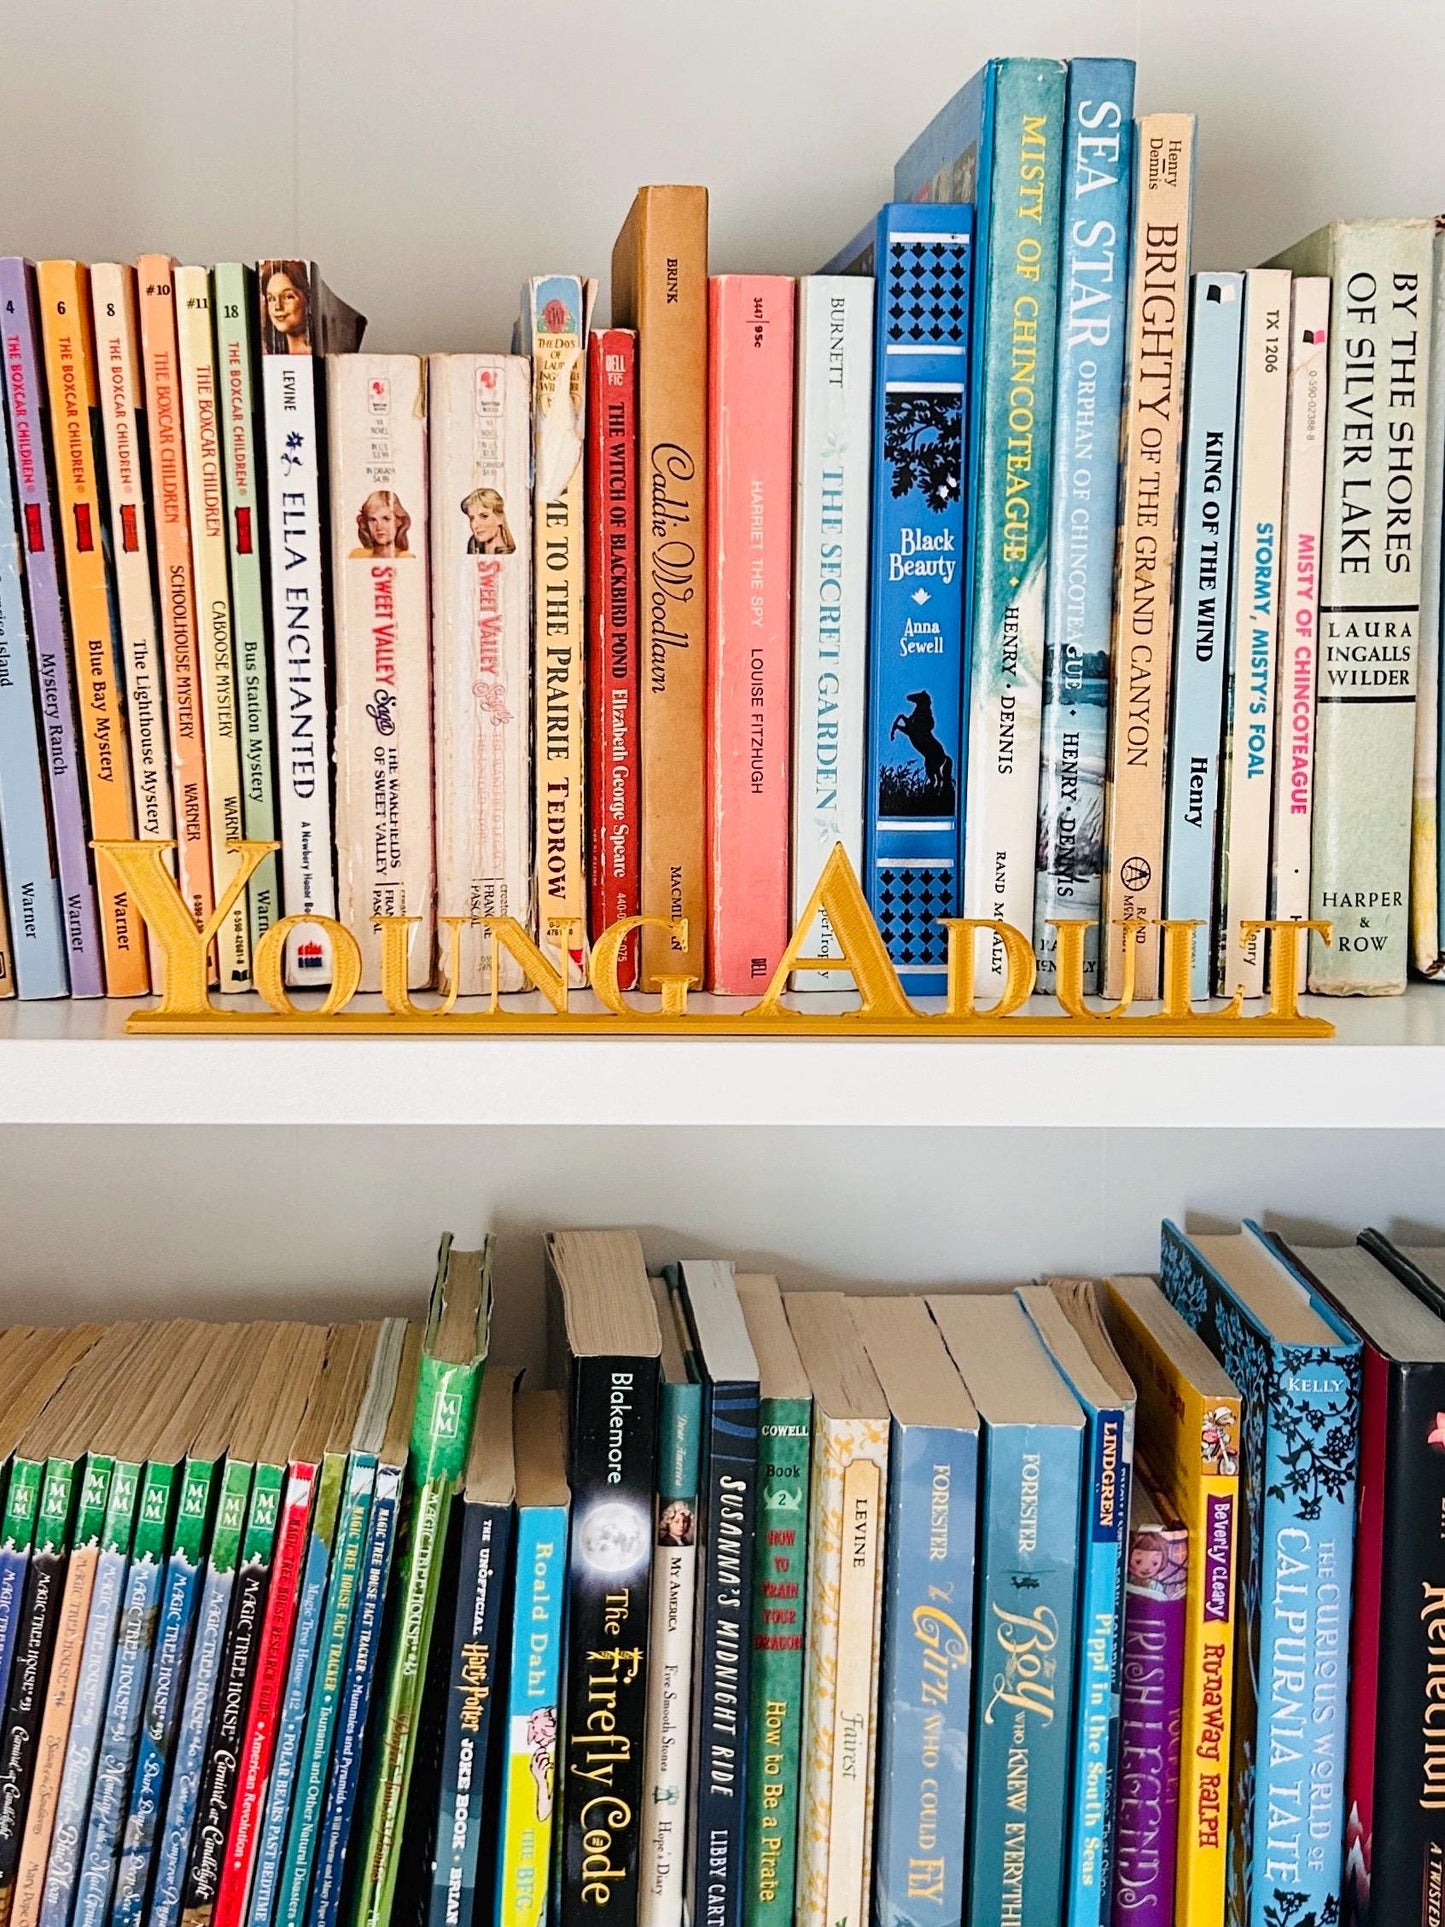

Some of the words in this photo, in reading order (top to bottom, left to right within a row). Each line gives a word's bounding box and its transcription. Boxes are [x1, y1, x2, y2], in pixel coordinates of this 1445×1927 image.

[1018, 114, 1046, 225] MISTY
[1075, 99, 1122, 199] SEA
[1148, 138, 1163, 190] Dennis
[1164, 140, 1182, 187] Henry
[666, 258, 678, 305] BRINK
[1016, 238, 1042, 282] OF
[1067, 219, 1116, 351] STAR
[6, 301, 15, 315] 4
[56, 301, 65, 315] 6
[107, 303, 116, 317] 8
[145, 285, 170, 296] #10
[187, 298, 208, 310] #11
[224, 305, 240, 319] 18
[754, 298, 764, 320] 3447
[1346, 272, 1377, 324] OF
[1392, 272, 1419, 319] BY
[829, 298, 845, 390] BURNETT
[1138, 222, 1180, 421] BRIGHTY
[1265, 310, 1279, 331] TX
[154, 351, 169, 381] THE
[1264, 338, 1279, 374] 1206
[1389, 331, 1417, 408] THE
[157, 386, 174, 444] BOXCAR
[282, 370, 297, 412] LEVINE
[1074, 361, 1097, 459] ORPHAN
[1343, 338, 1377, 469] SILVER
[608, 402, 625, 437] THE
[1002, 295, 1038, 562] CHINCOTEAGUE
[1140, 428, 1162, 464] OF
[159, 448, 180, 525] CHILDREN
[609, 443, 627, 502] WITCH
[651, 443, 695, 538] Caddie
[1072, 469, 1092, 501] OF
[1383, 422, 1414, 574] SHORES
[610, 506, 627, 530] OF
[750, 480, 764, 551] HARRIET
[1137, 472, 1160, 527] THE
[282, 493, 307, 570] ELLA
[900, 527, 955, 556] Black
[1338, 480, 1372, 574] LAKE
[546, 536, 569, 571] TO
[750, 560, 764, 589] THE
[889, 553, 956, 584] Beauty
[1249, 522, 1273, 621] STORMY,
[610, 534, 628, 628] BLACKBIRD
[1065, 508, 1089, 690] CHINCOTEAGUE
[1132, 536, 1157, 635] GRAND
[169, 565, 188, 673] SCHOOLHOUSE
[546, 580, 569, 636] THE
[651, 541, 695, 694] Woodlawn
[751, 595, 764, 627] SPY
[904, 617, 941, 637] Anna
[1328, 623, 1411, 638] LAURA
[88, 640, 104, 676] Blue
[611, 632, 628, 679] POND
[900, 636, 944, 657] Sewell
[1248, 629, 1269, 715] MISTY'S
[1326, 646, 1411, 662] INGALLS
[89, 681, 107, 712] Bay
[286, 588, 314, 800] ENCHANTED
[751, 648, 764, 707] LOUISE
[1327, 670, 1411, 686] WILDER
[175, 676, 194, 740] MYSTERY
[545, 647, 572, 761] PRAIRIE
[611, 690, 629, 762] Elizabeth
[1127, 645, 1153, 768] CANYON
[92, 717, 113, 783] Mystery
[751, 714, 764, 795] FITZHUGH
[1060, 733, 1080, 802] HENRY
[1247, 725, 1266, 780] FOAL
[184, 783, 201, 842] WARNER
[609, 766, 629, 821] George
[299, 831, 312, 870] Newbery
[547, 777, 570, 901] TEDROW
[609, 824, 629, 879] Speare
[1057, 818, 1076, 897] DENNIS
[303, 873, 313, 899] Honor
[1322, 892, 1403, 908] HARPER
[90, 840, 698, 1017] YOUNG
[757, 840, 1333, 1018] ADULT
[1338, 937, 1388, 952] ROW
[1287, 1378, 1344, 1393] KELLY
[608, 1373, 632, 1484] Blakemore
[761, 1426, 808, 1438] COWELL
[764, 1464, 801, 1480] Book
[1099, 1422, 1118, 1527] LINDGREN
[778, 1494, 786, 1507] 2
[1019, 1453, 1041, 1554] FORESTER
[716, 1475, 746, 1607] SUSANNA'S
[853, 1499, 869, 1569] LEVINE
[1317, 1540, 1336, 1579] THE
[531, 1542, 555, 1620] Roald
[669, 1557, 682, 1577] MY
[604, 1588, 629, 1636] The
[666, 1580, 681, 1632] AMERICA
[528, 1632, 549, 1697] Dahl
[1088, 1612, 1113, 1673] Pippi
[1269, 1527, 1311, 1768] CALPURNIA
[1312, 1582, 1341, 1721] CURIOUS
[662, 1665, 678, 1688] Five
[711, 1619, 741, 1737] MIDNIGHT
[1090, 1682, 1109, 1706] in
[312, 1706, 332, 1760] Tsunamis
[345, 1683, 364, 1734] Mummies
[571, 1646, 645, 1788] Firefly
[661, 1691, 678, 1733] Smooth
[766, 1701, 789, 1747] How
[1087, 1715, 1109, 1754] the
[246, 1732, 266, 1790] American
[278, 1733, 297, 1776] POLAR
[342, 1735, 354, 1756] and
[457, 1738, 474, 1792] JOKE
[660, 1736, 676, 1773] Stones
[764, 1753, 786, 1776] to
[840, 1710, 864, 1781] Fairest
[922, 1712, 942, 1768] WHO
[310, 1761, 325, 1783] and
[333, 1757, 353, 1805] Pyramids
[709, 1745, 736, 1798] RIDE
[764, 1783, 785, 1810] Be
[1083, 1761, 1105, 1827] South
[1306, 1733, 1336, 1839] WORLD
[234, 1793, 257, 1858] Revolution
[271, 1779, 290, 1822] BEARS
[304, 1785, 321, 1821] Other
[452, 1794, 470, 1850] BOOK
[763, 1815, 779, 1829] a
[918, 1780, 938, 1850] COULD
[264, 1825, 281, 1859] PAST
[295, 1823, 314, 1865] Natural
[580, 1796, 633, 1907] Code
[656, 1822, 673, 1861] Hope's
[708, 1830, 729, 1878] LIBBY
[1264, 1780, 1303, 1884] TATE
[651, 1864, 670, 1896] Diary
[758, 1836, 783, 1903] Pirate
[907, 1856, 946, 1906] FLY
[1081, 1837, 1101, 1886] Seas
[1307, 1846, 1326, 1872] OF
[255, 1861, 276, 1921] BEDTIME
[288, 1867, 307, 1919] Disasters
